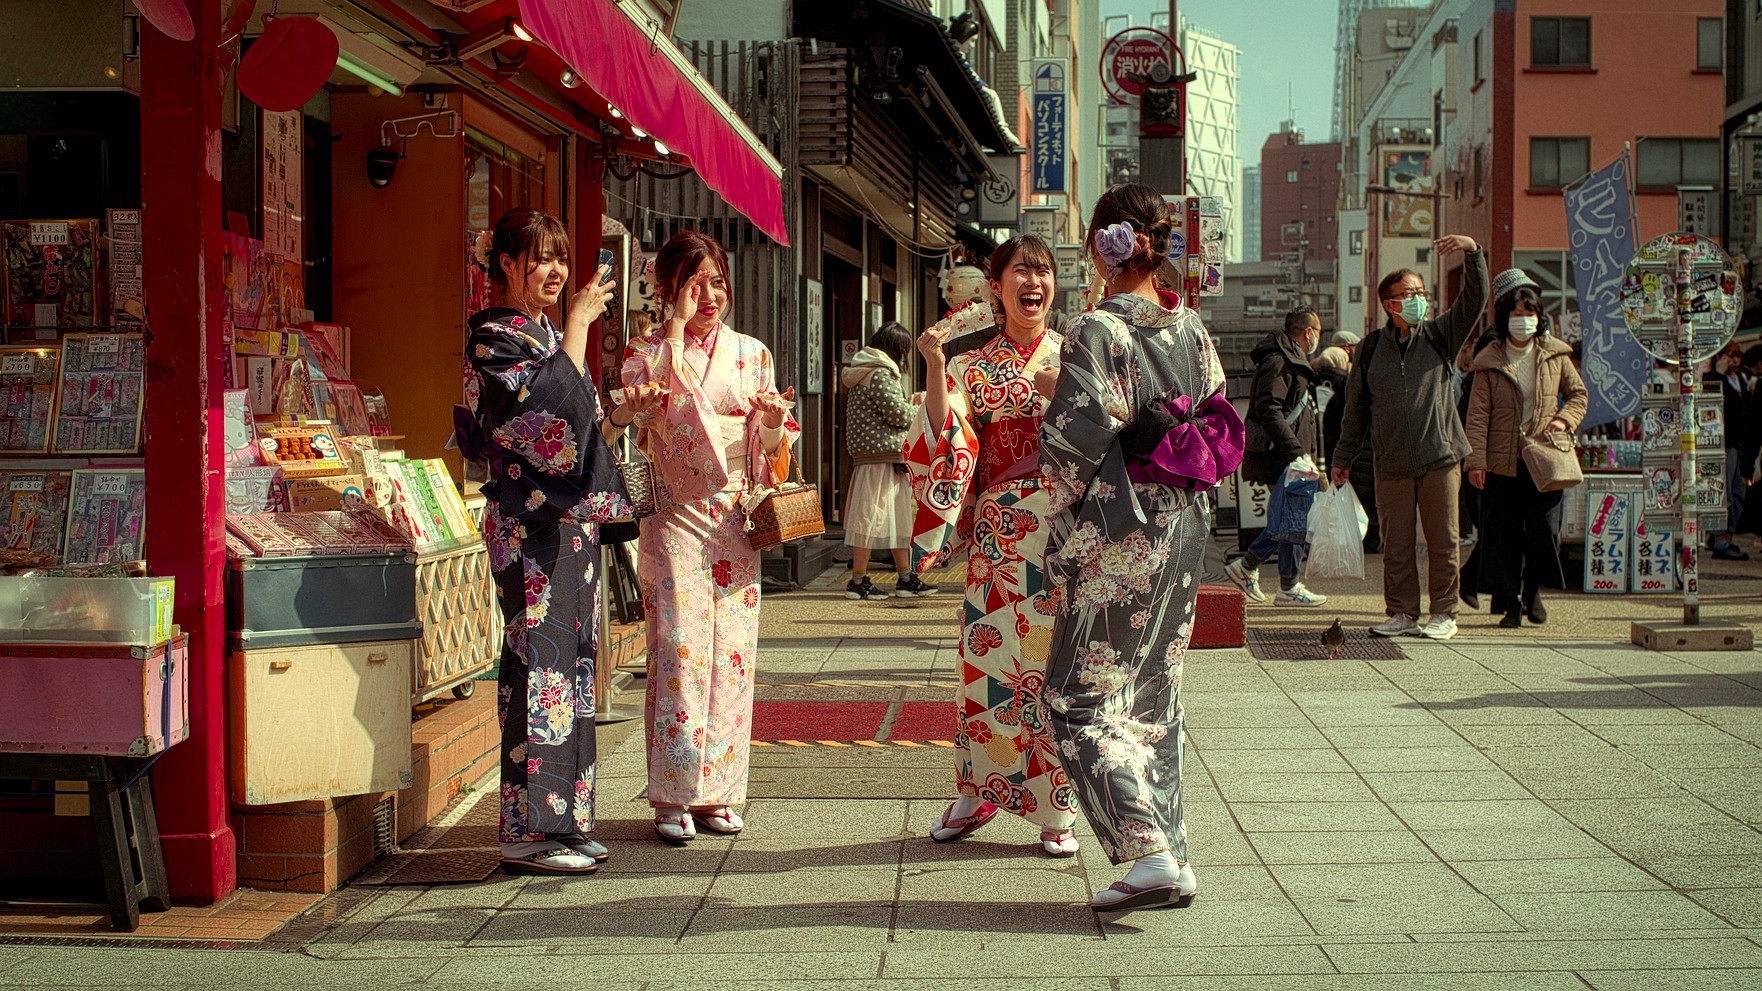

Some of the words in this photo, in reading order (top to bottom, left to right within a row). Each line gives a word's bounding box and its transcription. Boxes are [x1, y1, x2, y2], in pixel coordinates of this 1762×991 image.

[1037, 100, 1050, 188] パソコンスクール
[1052, 96, 1063, 165] フォーティネット
[248, 469, 271, 477] 人形焼
[1591, 541, 1605, 576] 各種
[1608, 528, 1624, 574] ラムネ
[1638, 541, 1652, 576] 各種
